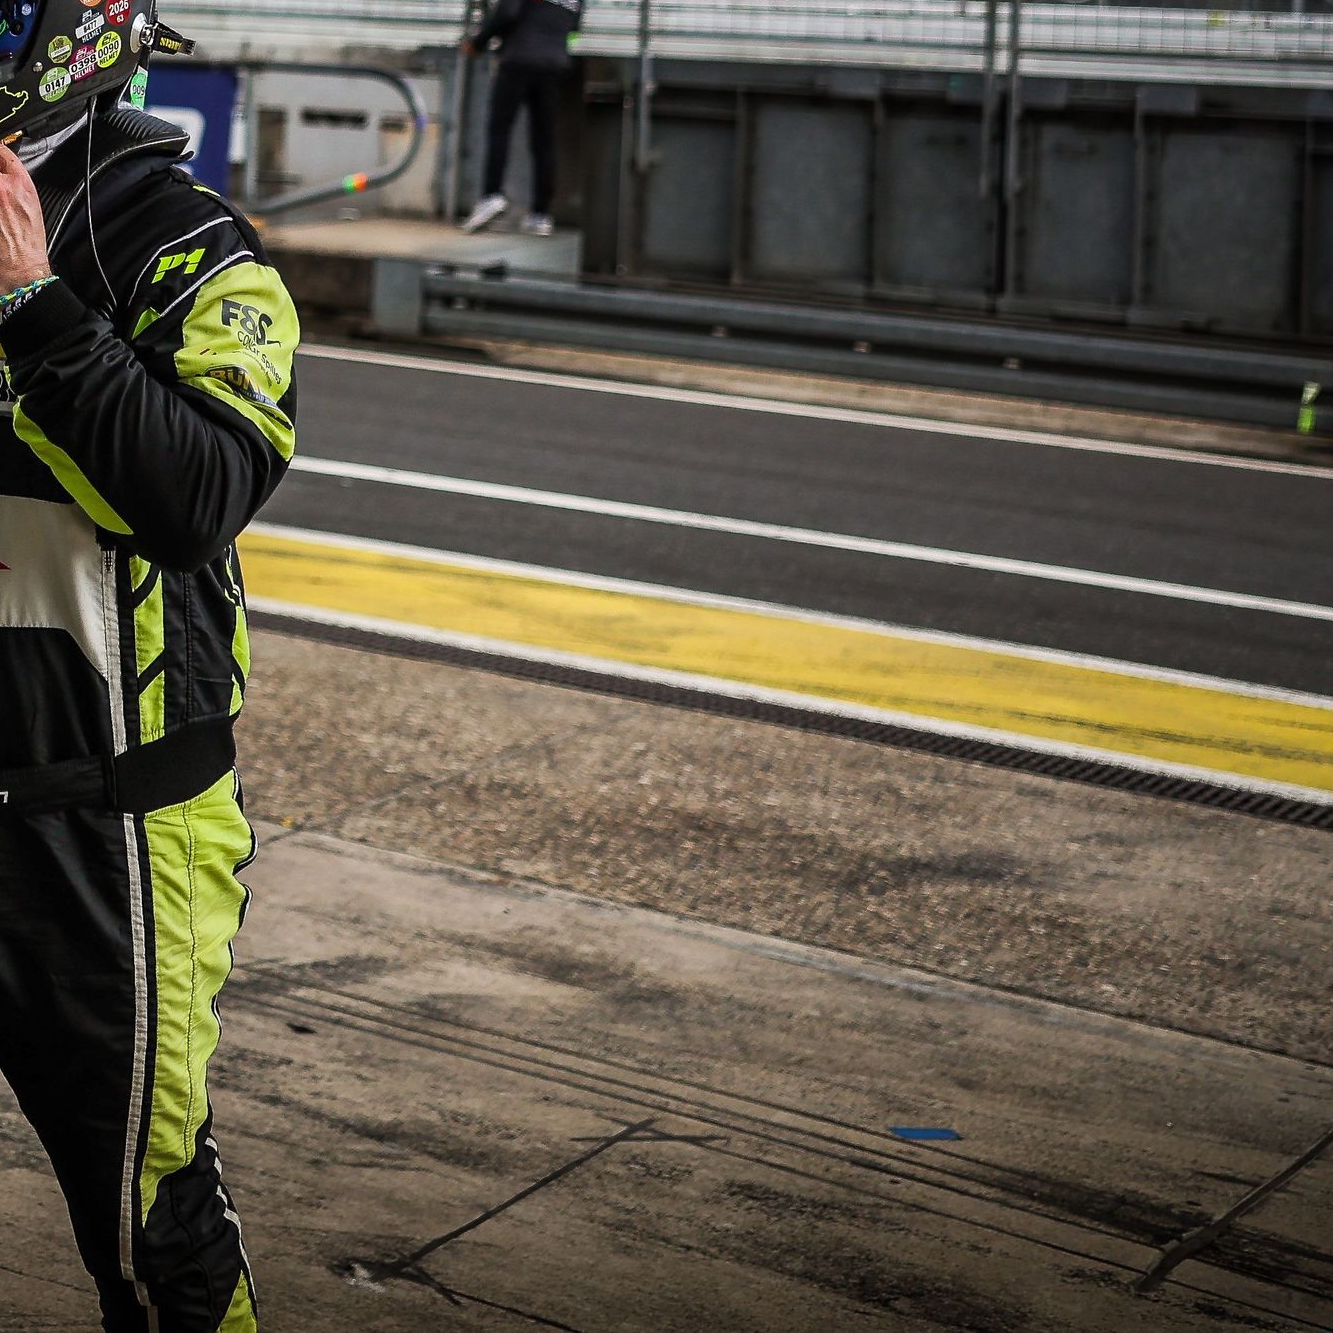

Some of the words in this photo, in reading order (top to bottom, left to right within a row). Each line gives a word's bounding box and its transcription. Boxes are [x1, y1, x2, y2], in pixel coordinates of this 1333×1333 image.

[81, 26, 103, 45] HELMET
[97, 40, 121, 60] 0090
[99, 49, 119, 69] HELMET
[70, 54, 98, 74] 0398
[74, 64, 97, 81] HELMET
[44, 77, 67, 94] 0147
[152, 248, 206, 284] P1
